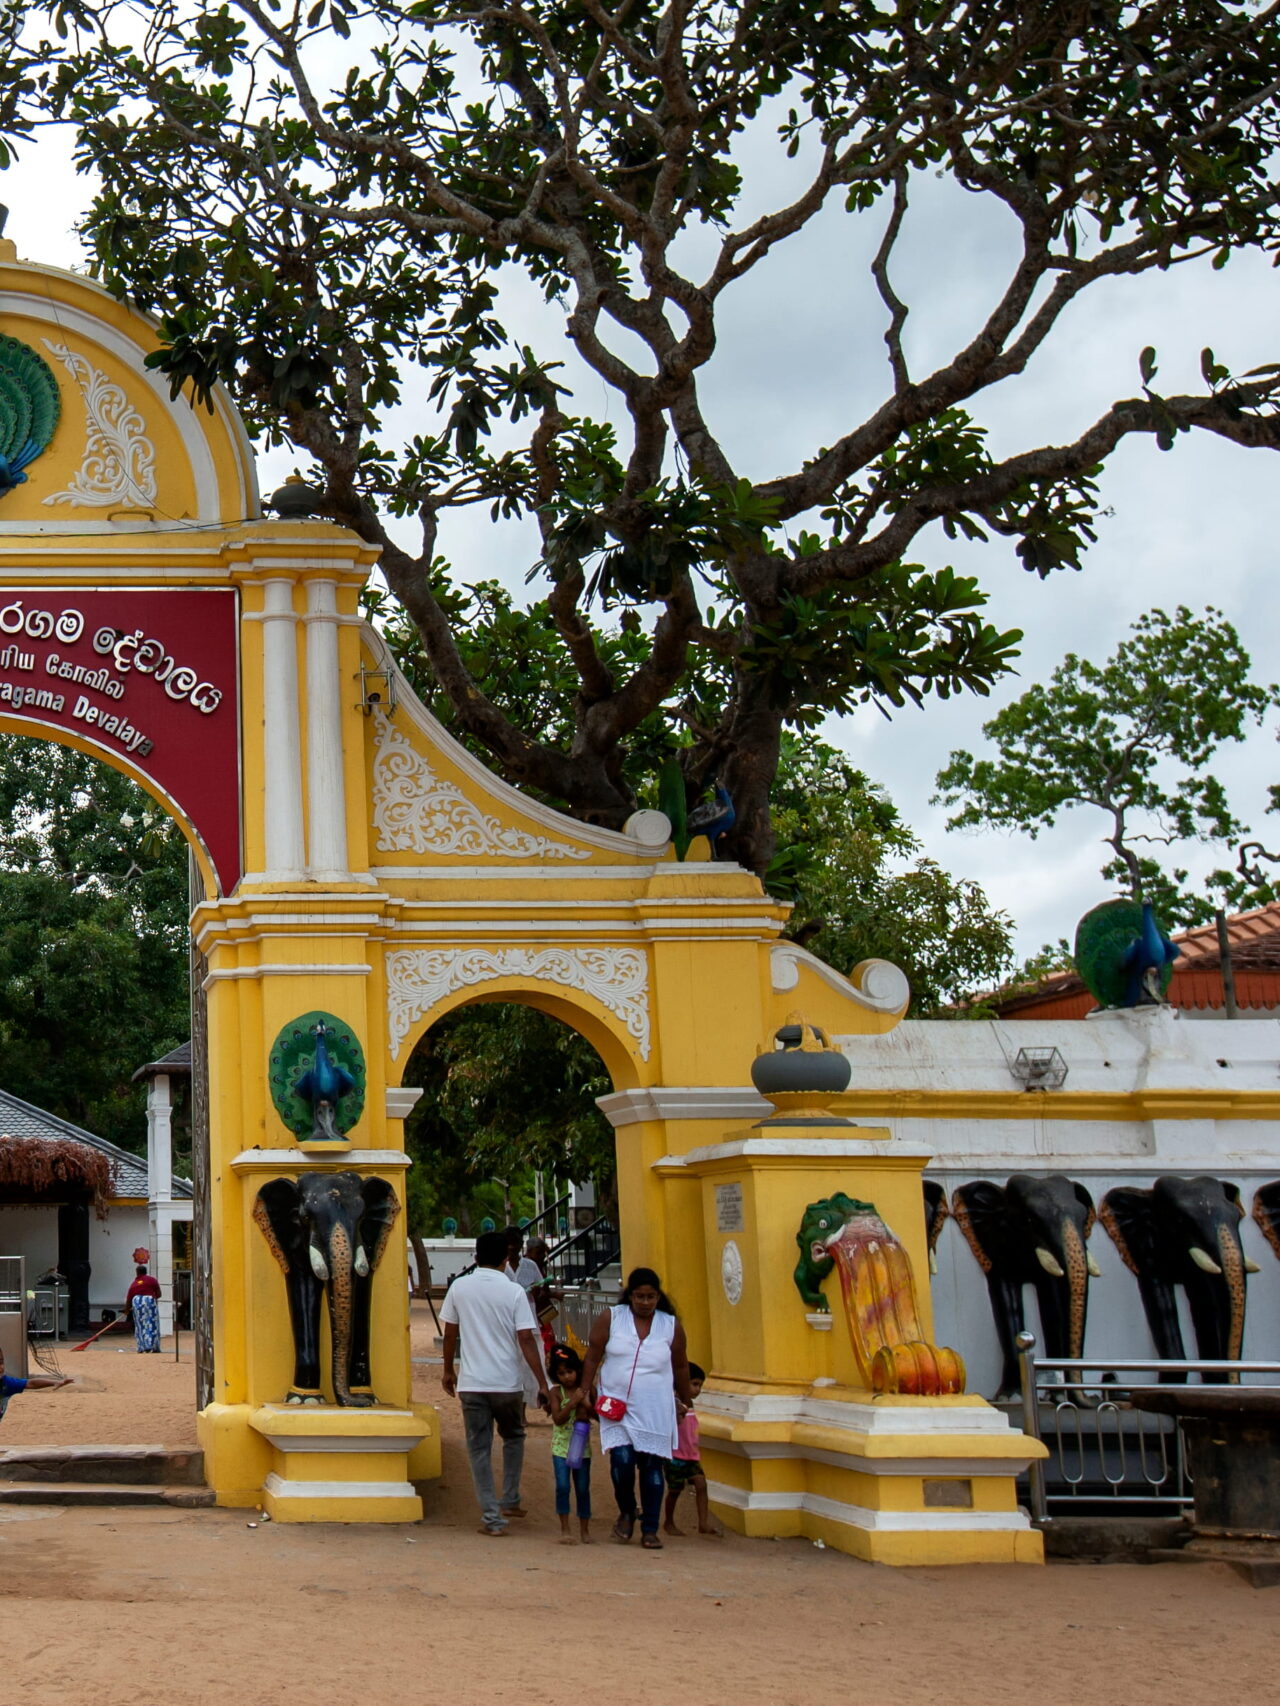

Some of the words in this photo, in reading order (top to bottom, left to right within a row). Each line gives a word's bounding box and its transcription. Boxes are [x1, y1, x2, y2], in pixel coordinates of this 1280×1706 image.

[45, 654, 125, 700] கோவில்
[93, 627, 223, 713] දේවාලය
[72, 695, 154, 757] Devalaya
